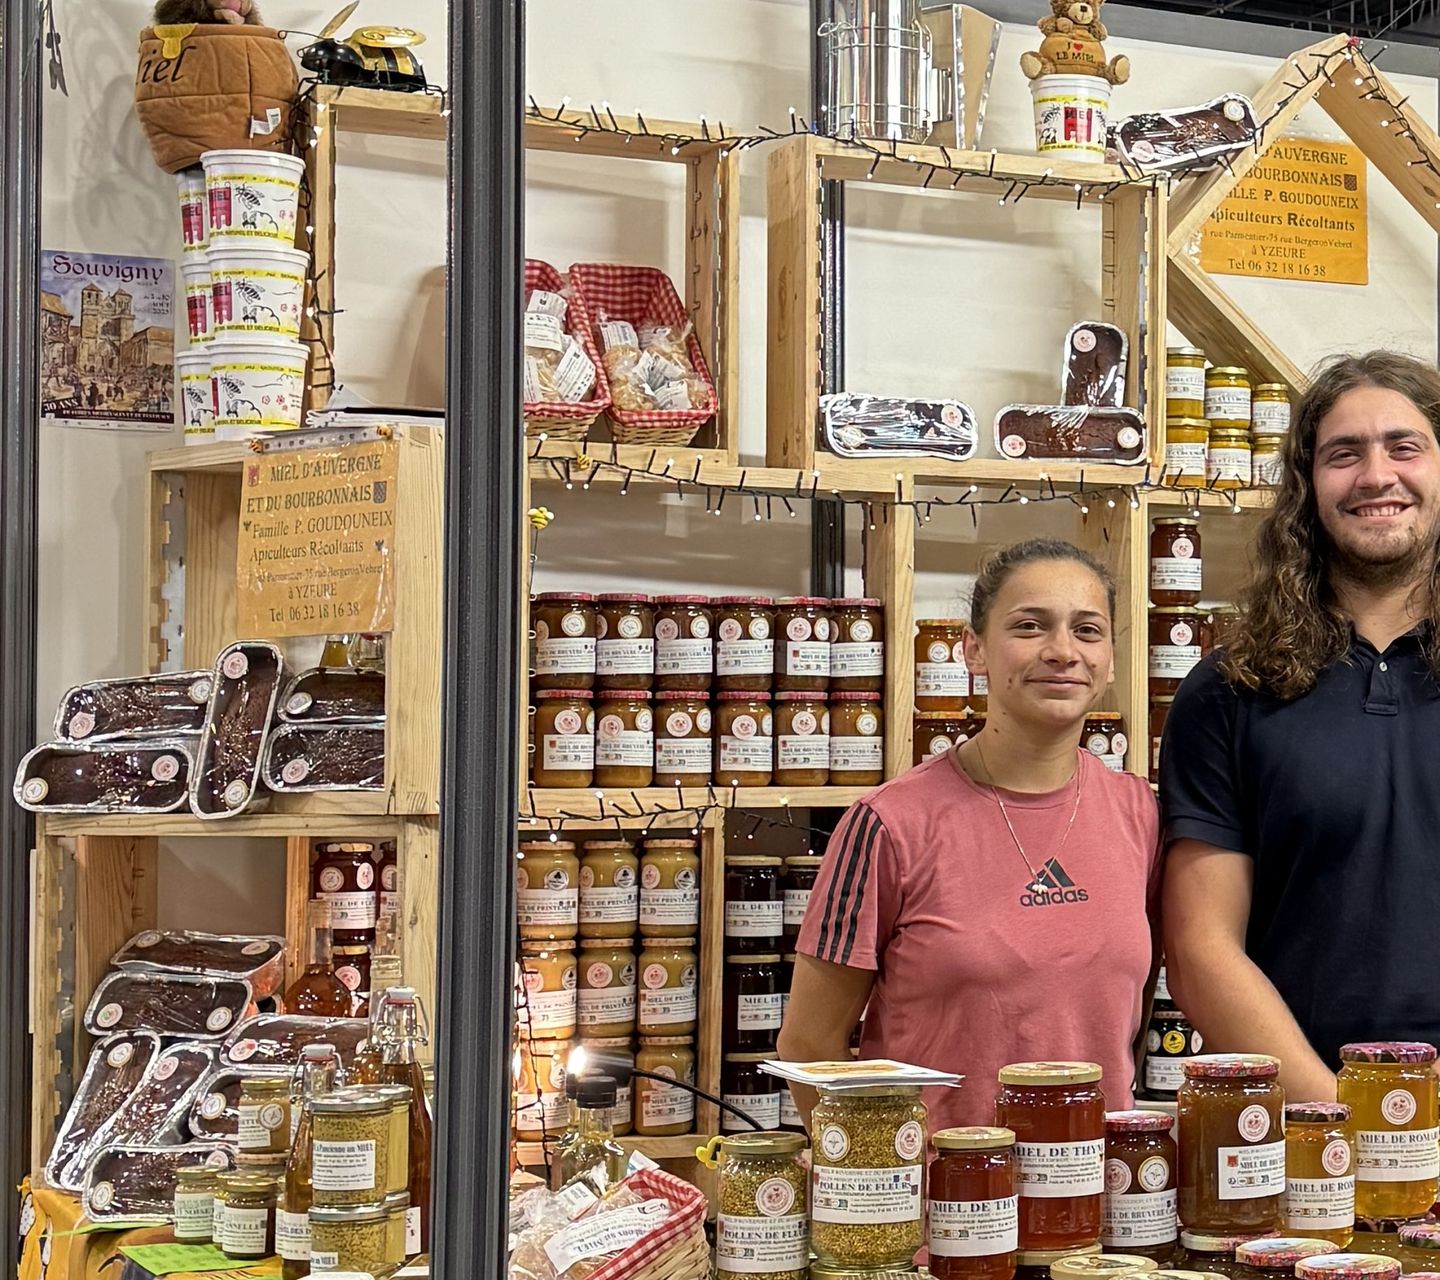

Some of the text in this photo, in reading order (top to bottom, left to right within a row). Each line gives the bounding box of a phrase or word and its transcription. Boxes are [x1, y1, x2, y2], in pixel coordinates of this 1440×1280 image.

[142, 45, 197, 83] iel
[1264, 190, 1275, 202] P.
[1280, 191, 1359, 209] GOUDOUNEIX
[1288, 212, 1355, 231] Récoltants
[1252, 245, 1306, 258] à YZEURE
[53, 255, 163, 285] Souvigny
[1228, 259, 1326, 276] Tel 06 32 18 16 38
[270, 454, 382, 482] MIEL D'AUVERGNE
[247, 484, 371, 513] ET DU BOURBONNAIS
[253, 511, 392, 539] Famille P. GOUDOUNEIX
[250, 539, 363, 565] Apiculteurs Récoltants
[288, 583, 337, 599] à YZEURE
[270, 602, 359, 622] Tel 06 32 18 16 38
[1020, 888, 1088, 906] adidas
[1360, 1133, 1388, 1143] MIEL
[1392, 1133, 1406, 1143] DE
[1012, 1146, 1046, 1158] MIEL
[1049, 1146, 1069, 1157] DE
[820, 1181, 856, 1191] POLLEN
[858, 1183, 872, 1191] DE
[1290, 1182, 1332, 1192] MIEL DE
[933, 1202, 966, 1213] MIEL
[971, 1202, 990, 1212] DE
[724, 1230, 779, 1240] POLLEN DE
